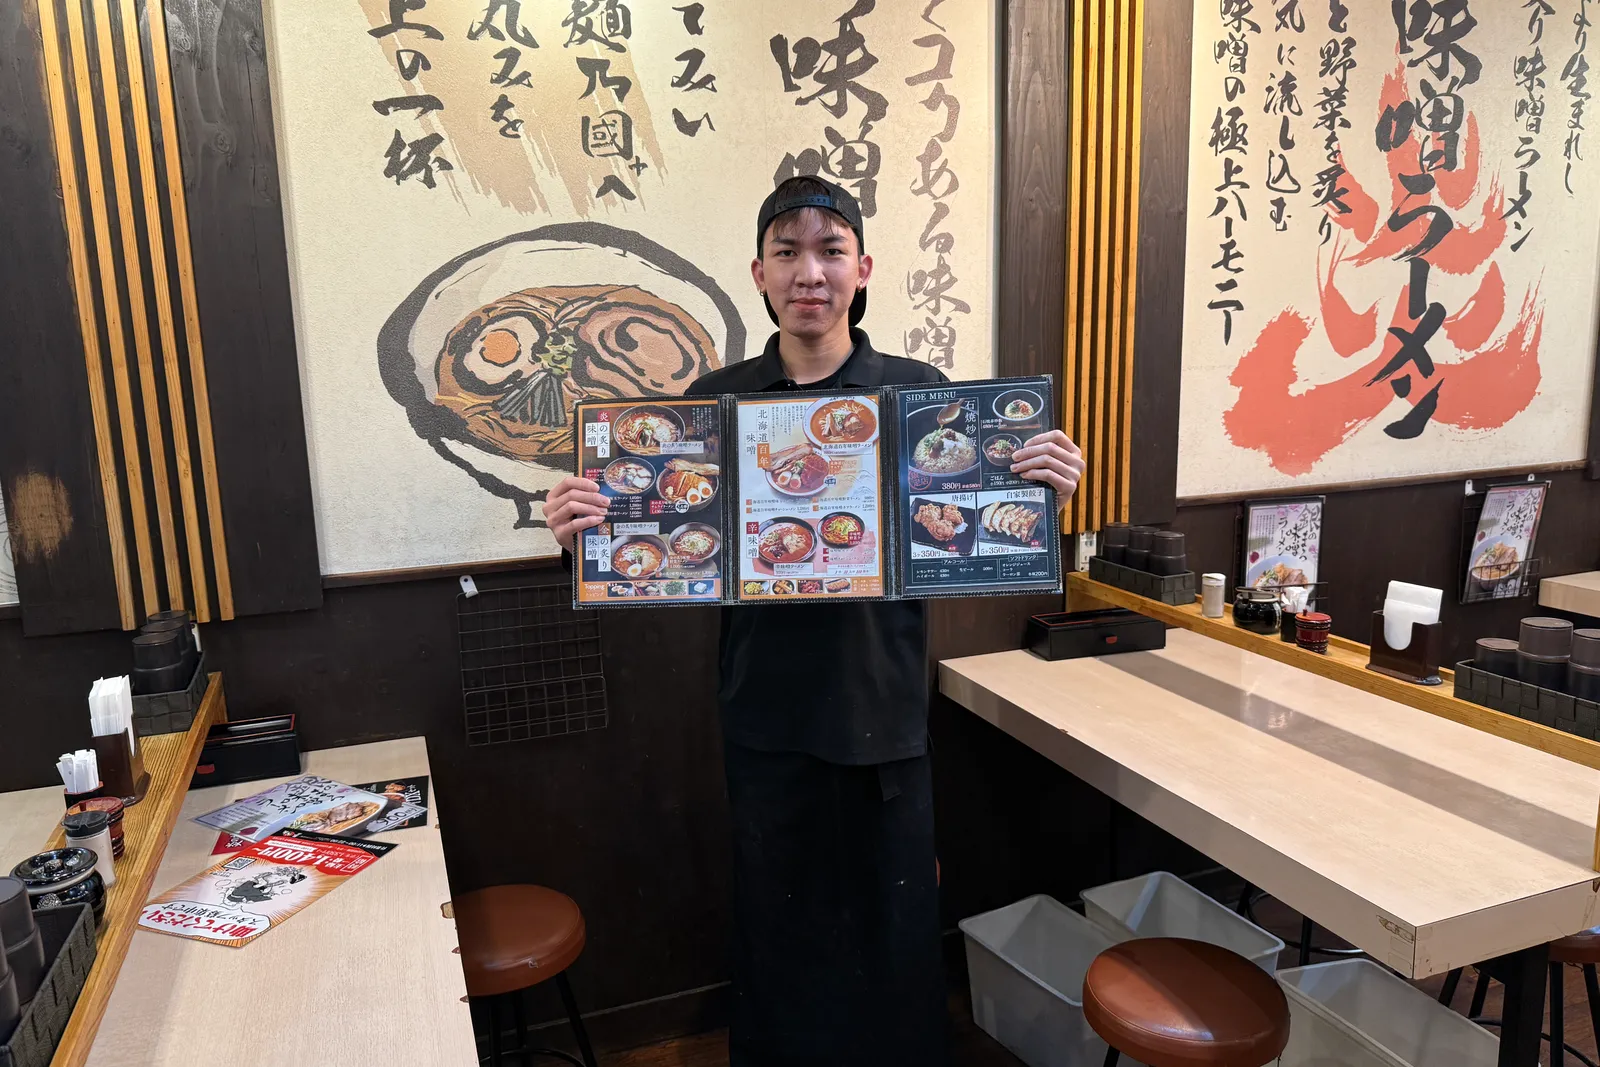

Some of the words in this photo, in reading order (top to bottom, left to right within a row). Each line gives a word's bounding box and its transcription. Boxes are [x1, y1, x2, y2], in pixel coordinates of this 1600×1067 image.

[1363, 0, 1483, 440] 味噌ラーメン
[906, 393, 927, 401] SIDE
[929, 391, 956, 400] MENU
[587, 423, 597, 445] 味噌
[746, 432, 757, 455] 味噌
[757, 408, 769, 466] 北海道百年
[941, 482, 961, 490] 380円
[1006, 489, 1044, 499] 自家製餃子
[952, 494, 974, 502] 唐揚げ
[587, 537, 597, 557] 味噌
[747, 523, 758, 557] 辛味噌
[1277, 517, 1288, 556] ラーメン
[584, 583, 605, 591] Topping
[161, 903, 265, 926] スタッフ募集中です
